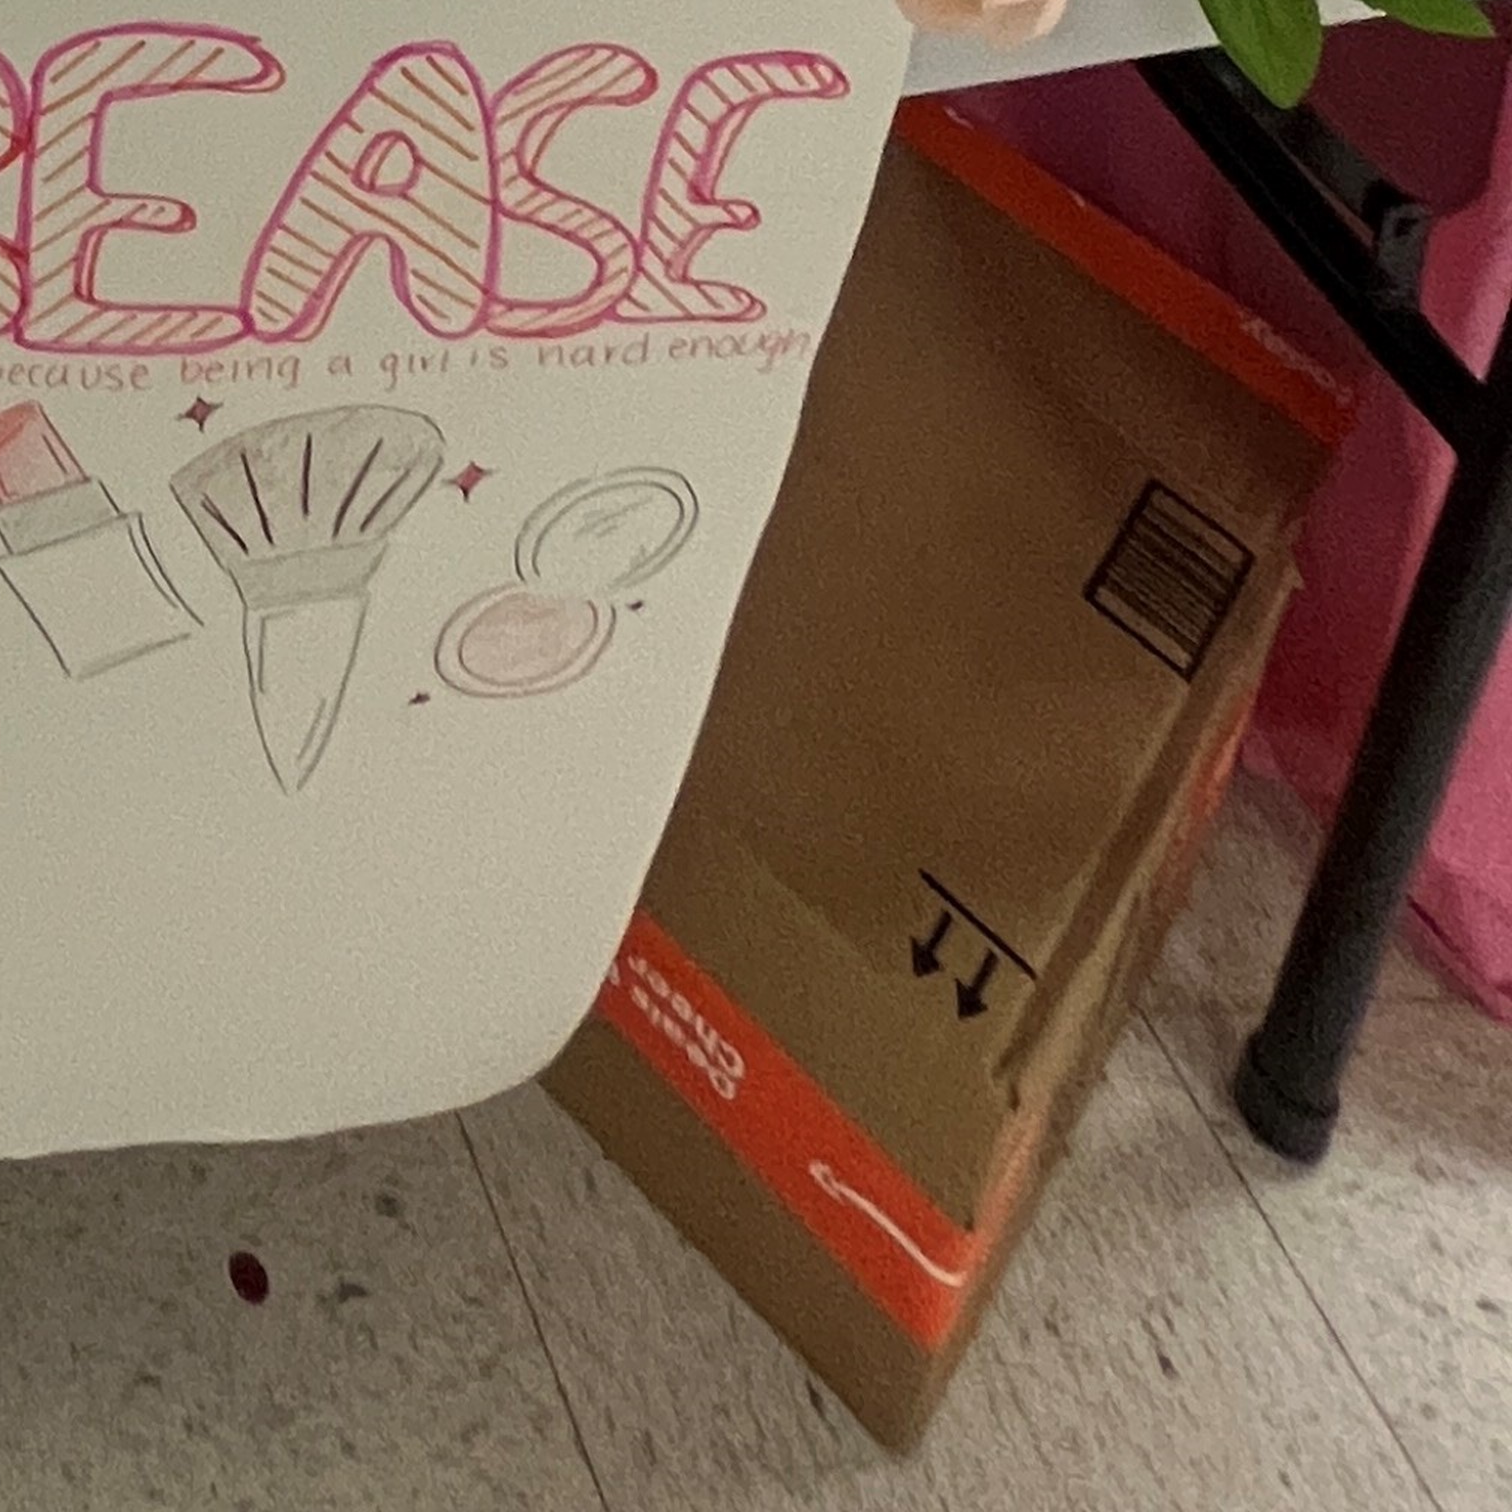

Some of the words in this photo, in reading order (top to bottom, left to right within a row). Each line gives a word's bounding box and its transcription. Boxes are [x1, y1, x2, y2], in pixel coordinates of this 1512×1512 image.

[180, 353, 300, 389] being
[326, 356, 352, 377] a
[380, 349, 450, 390] girl
[469, 343, 509, 368] is
